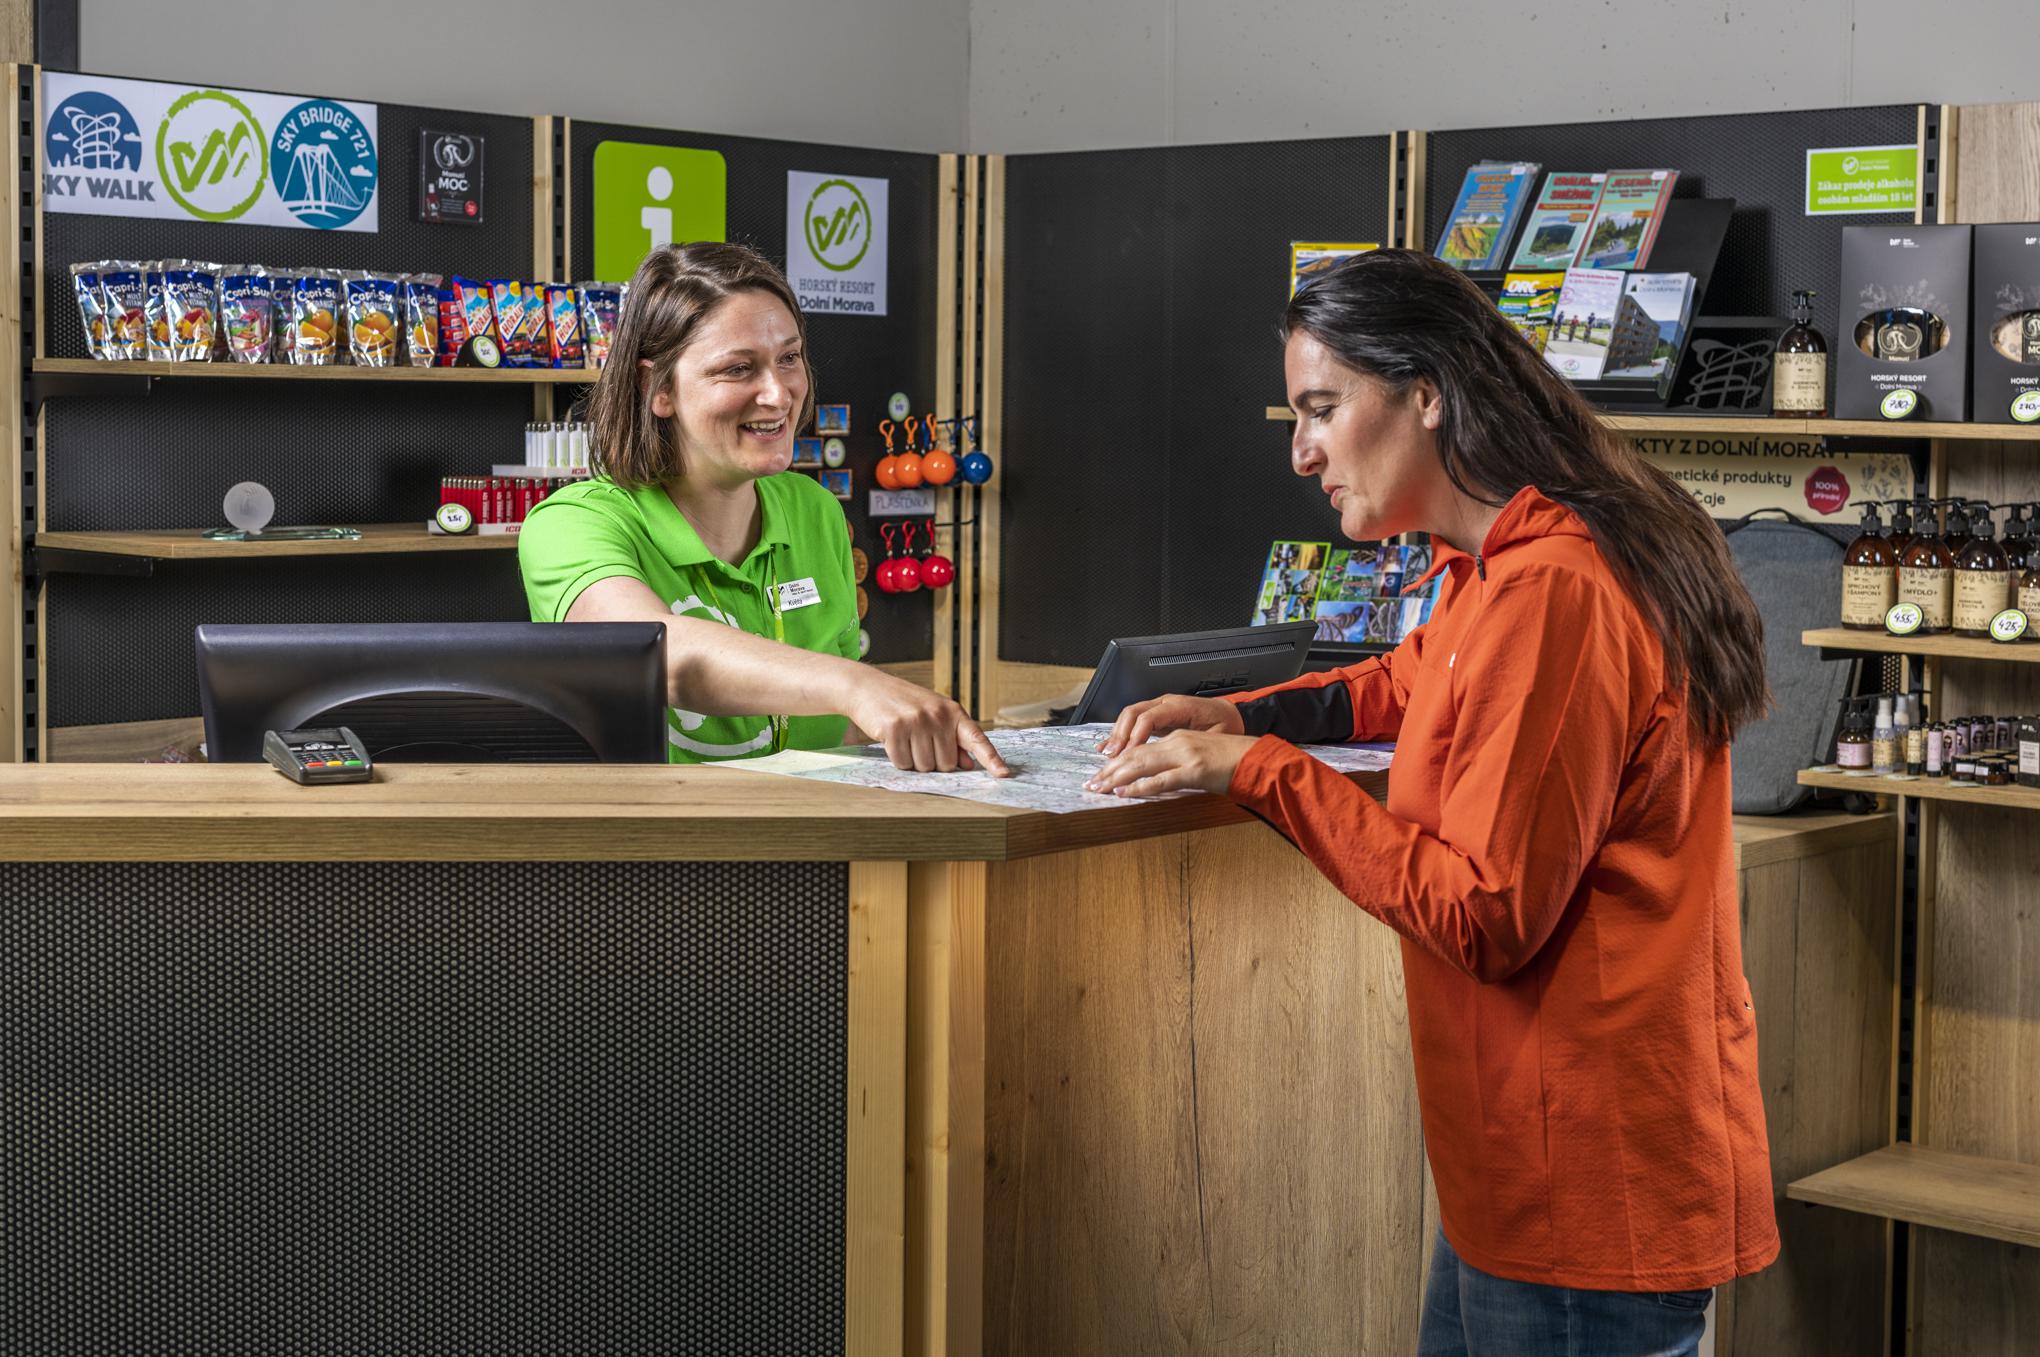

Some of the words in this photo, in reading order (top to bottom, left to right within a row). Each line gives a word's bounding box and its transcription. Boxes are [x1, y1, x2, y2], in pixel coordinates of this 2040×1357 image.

[277, 118, 300, 152] SKY
[298, 106, 353, 134] BRIDGE
[349, 128, 370, 158] 721
[85, 176, 156, 202] WALK
[438, 177, 468, 192] MOC
[799, 278, 838, 292] HORSKÝ
[839, 281, 876, 294] RESORT
[1507, 280, 1540, 293] ORC
[799, 295, 830, 309] Dolní
[832, 297, 875, 312] Morava
[1631, 437, 1674, 454] KTY
[1680, 439, 1691, 454] Z
[1696, 436, 1758, 457] DOLNÍ
[1764, 441, 1849, 459] MORA
[1723, 471, 1792, 487] produkty
